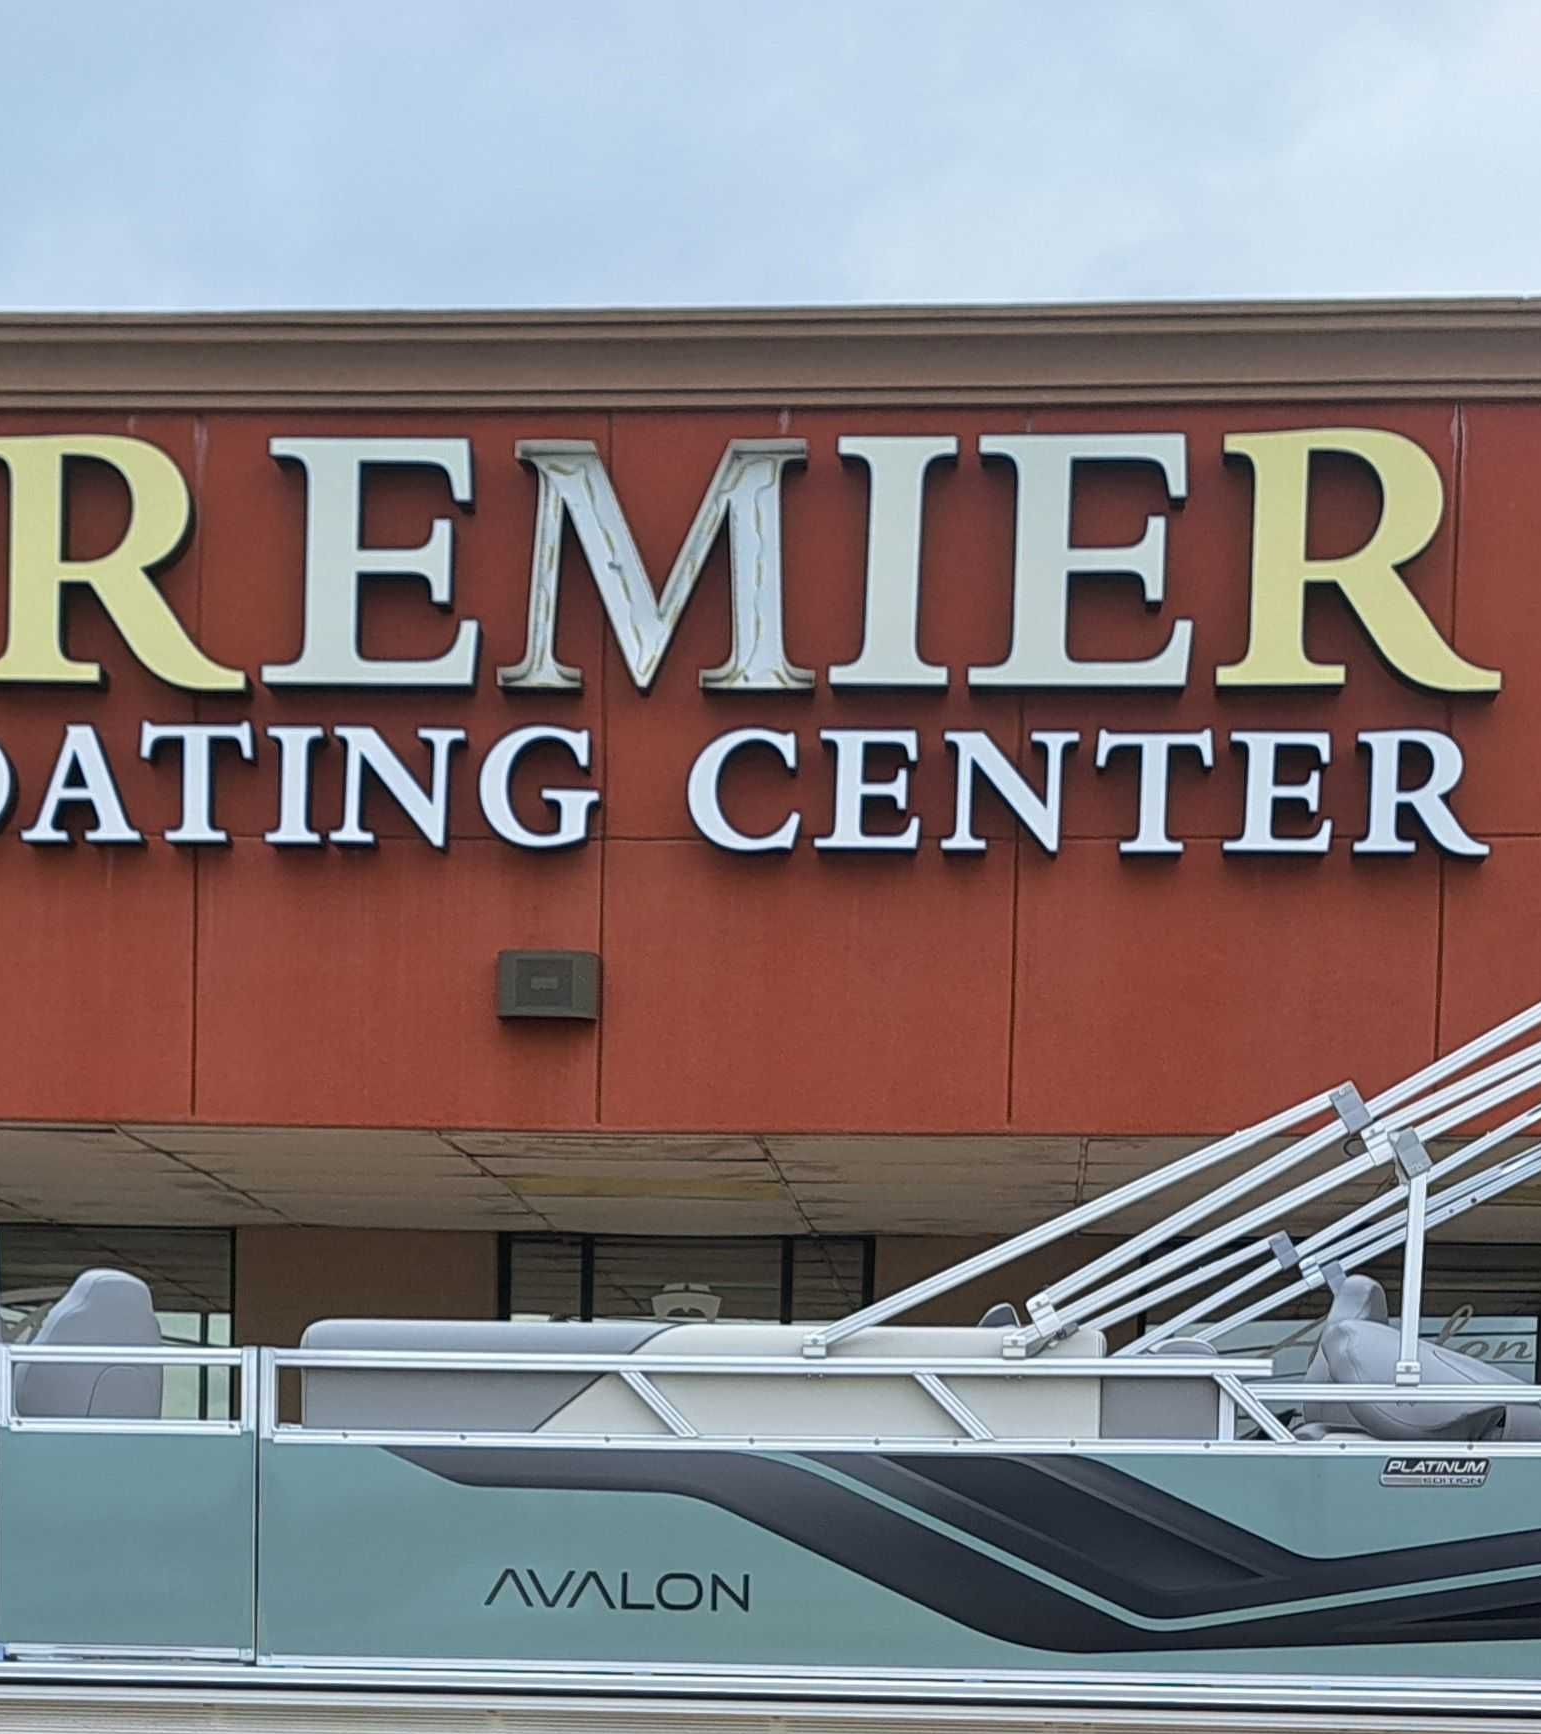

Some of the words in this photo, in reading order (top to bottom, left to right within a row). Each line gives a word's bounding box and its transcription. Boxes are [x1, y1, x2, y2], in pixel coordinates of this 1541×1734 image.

[686, 726, 1490, 858] CENTER
[1387, 1460, 1487, 1474] PLATINUM
[483, 1567, 751, 1613] AVALON
